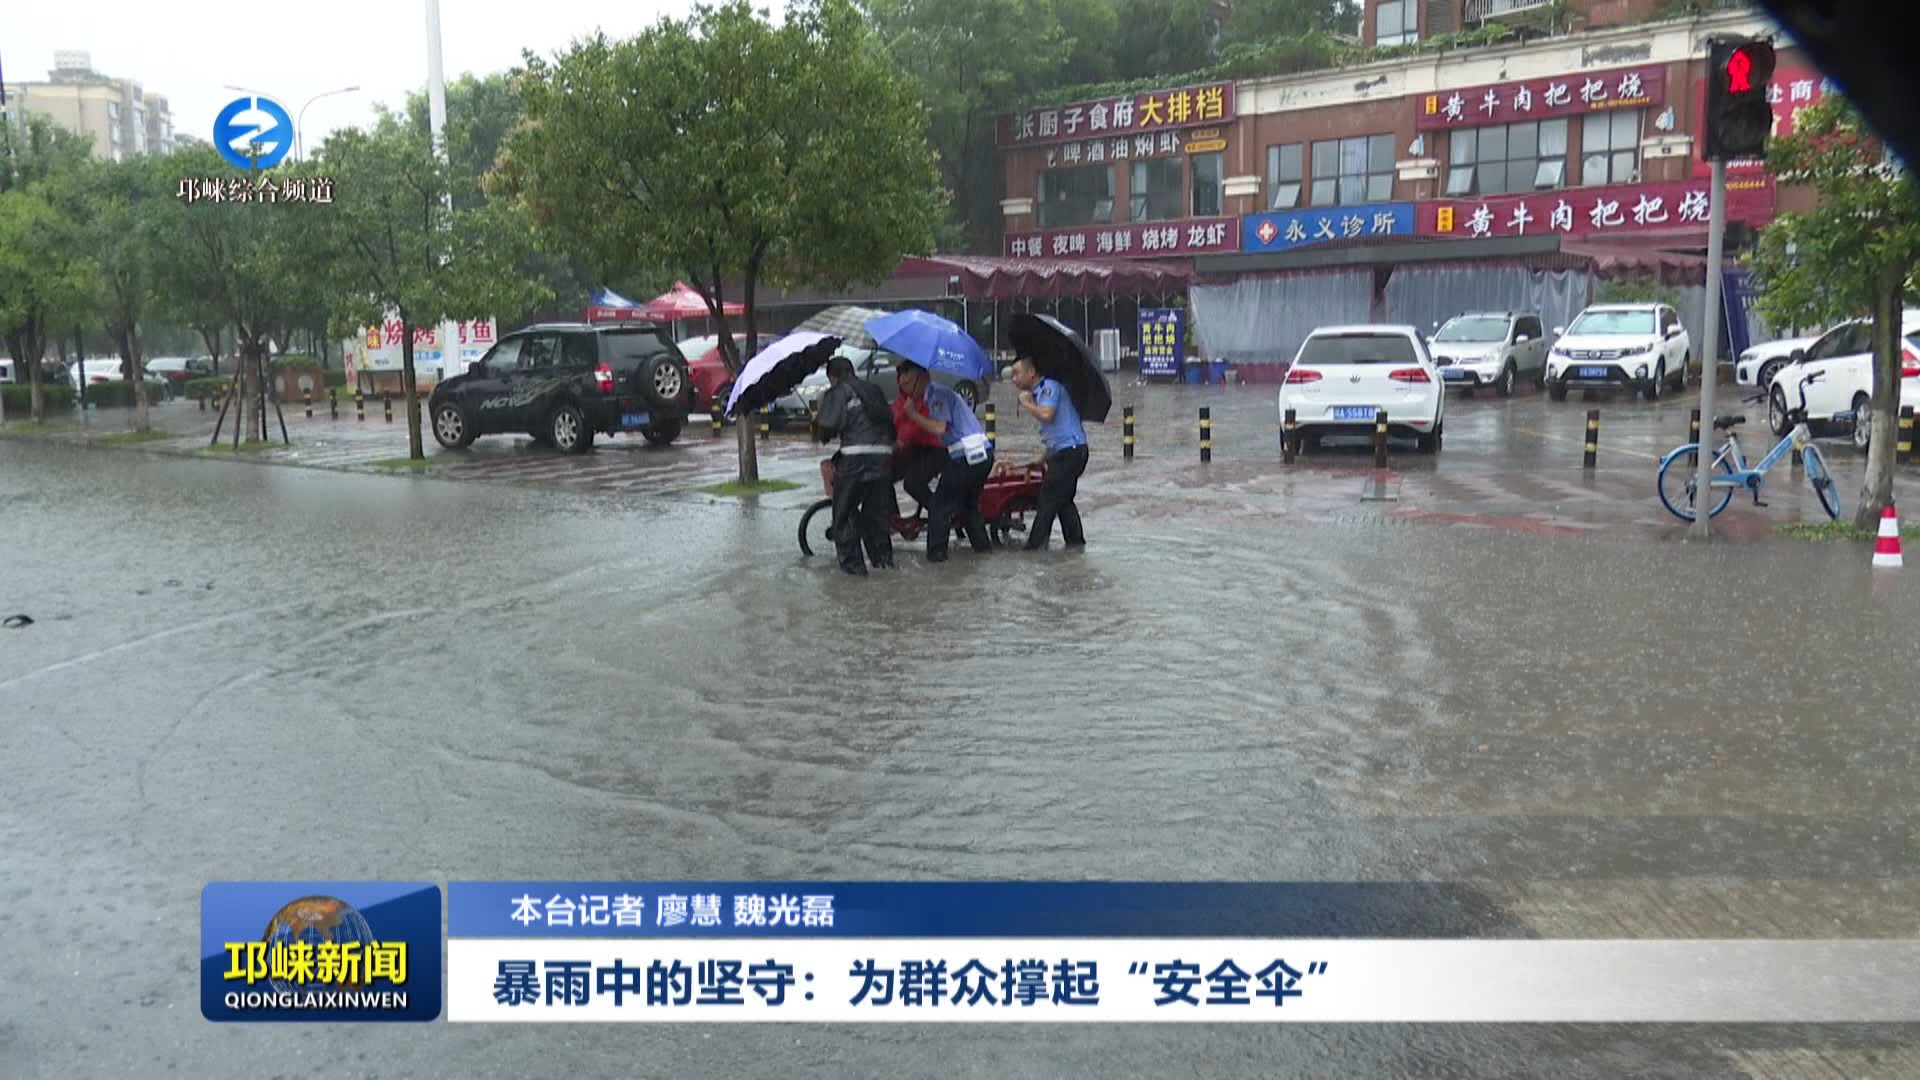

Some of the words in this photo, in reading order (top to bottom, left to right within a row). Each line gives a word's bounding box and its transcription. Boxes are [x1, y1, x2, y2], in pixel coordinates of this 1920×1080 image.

[1441, 73, 1645, 122] 黄牛肉把把烧
[1284, 211, 1396, 242] 永义诊所
[1464, 190, 1711, 238] 黄牛肉把把烧
[1011, 236, 1043, 258] 中餐
[1052, 233, 1086, 255] 夜啤
[1096, 230, 1132, 253] 海鲜
[1141, 226, 1179, 250] 烧烤
[1187, 223, 1226, 247] 龙虾
